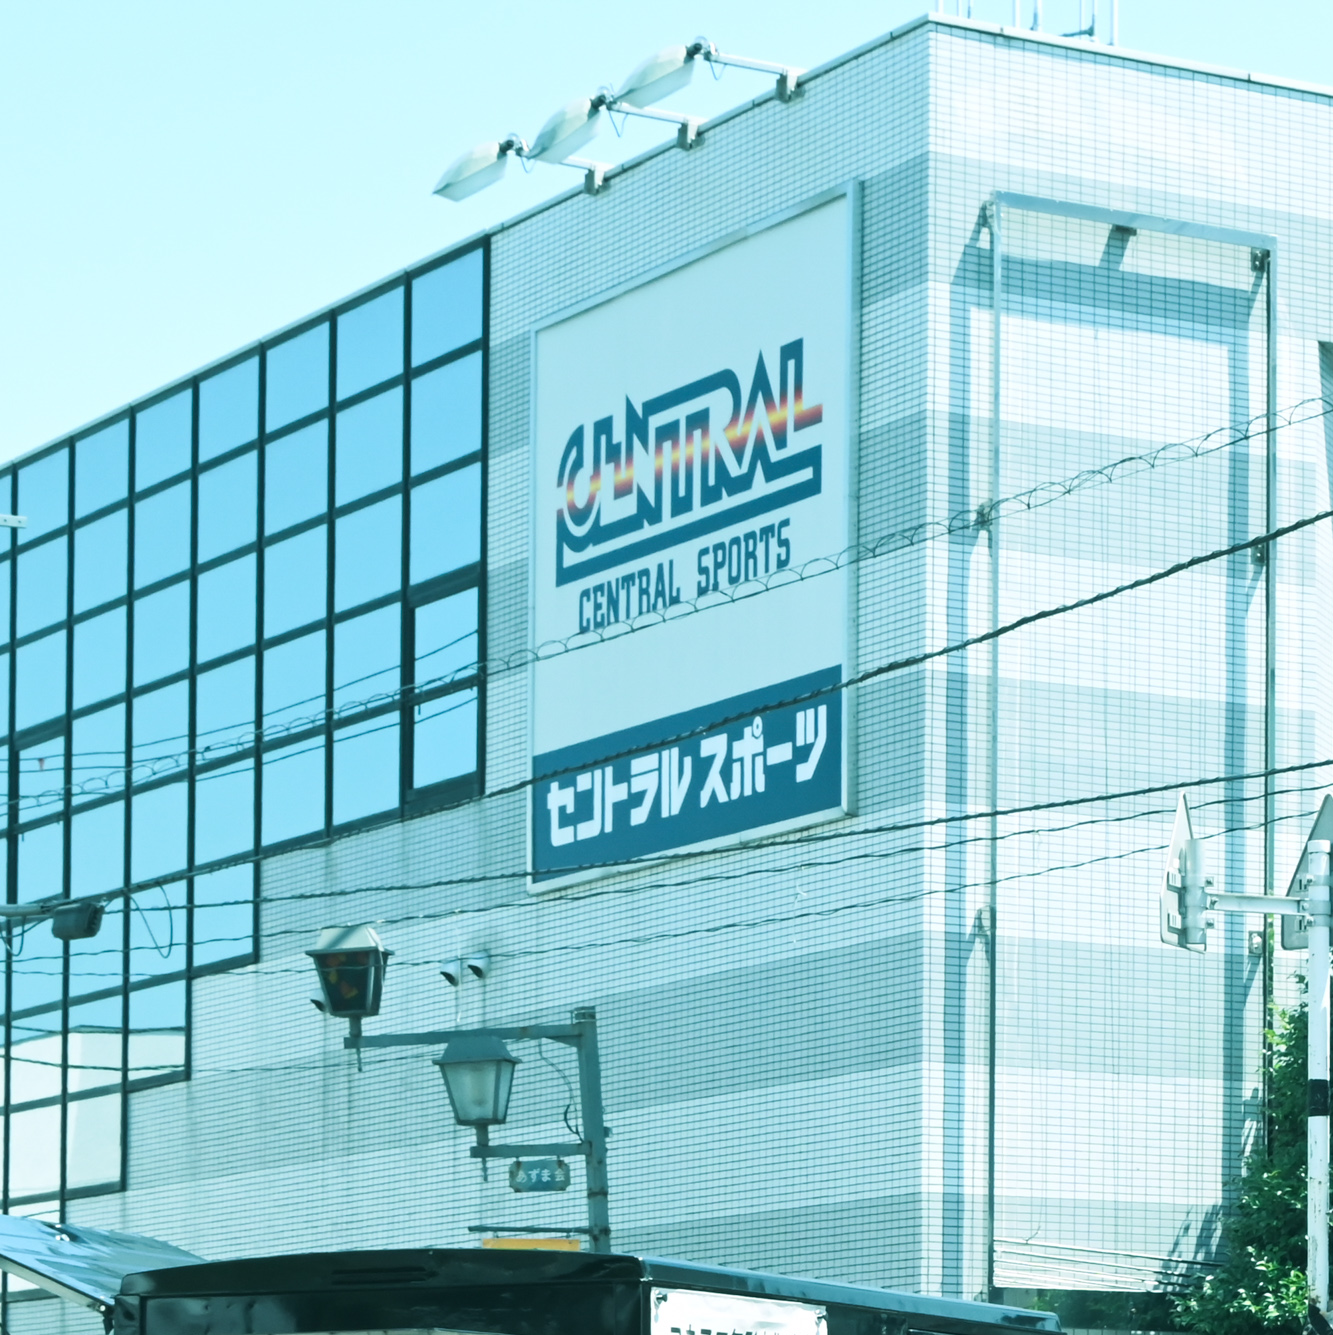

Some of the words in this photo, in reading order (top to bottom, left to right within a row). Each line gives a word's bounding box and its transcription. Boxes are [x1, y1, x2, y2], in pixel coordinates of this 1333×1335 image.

[555, 338, 823, 587] CENTRAL
[578, 559, 681, 635] CENTRAL
[697, 517, 791, 596] SPORTS
